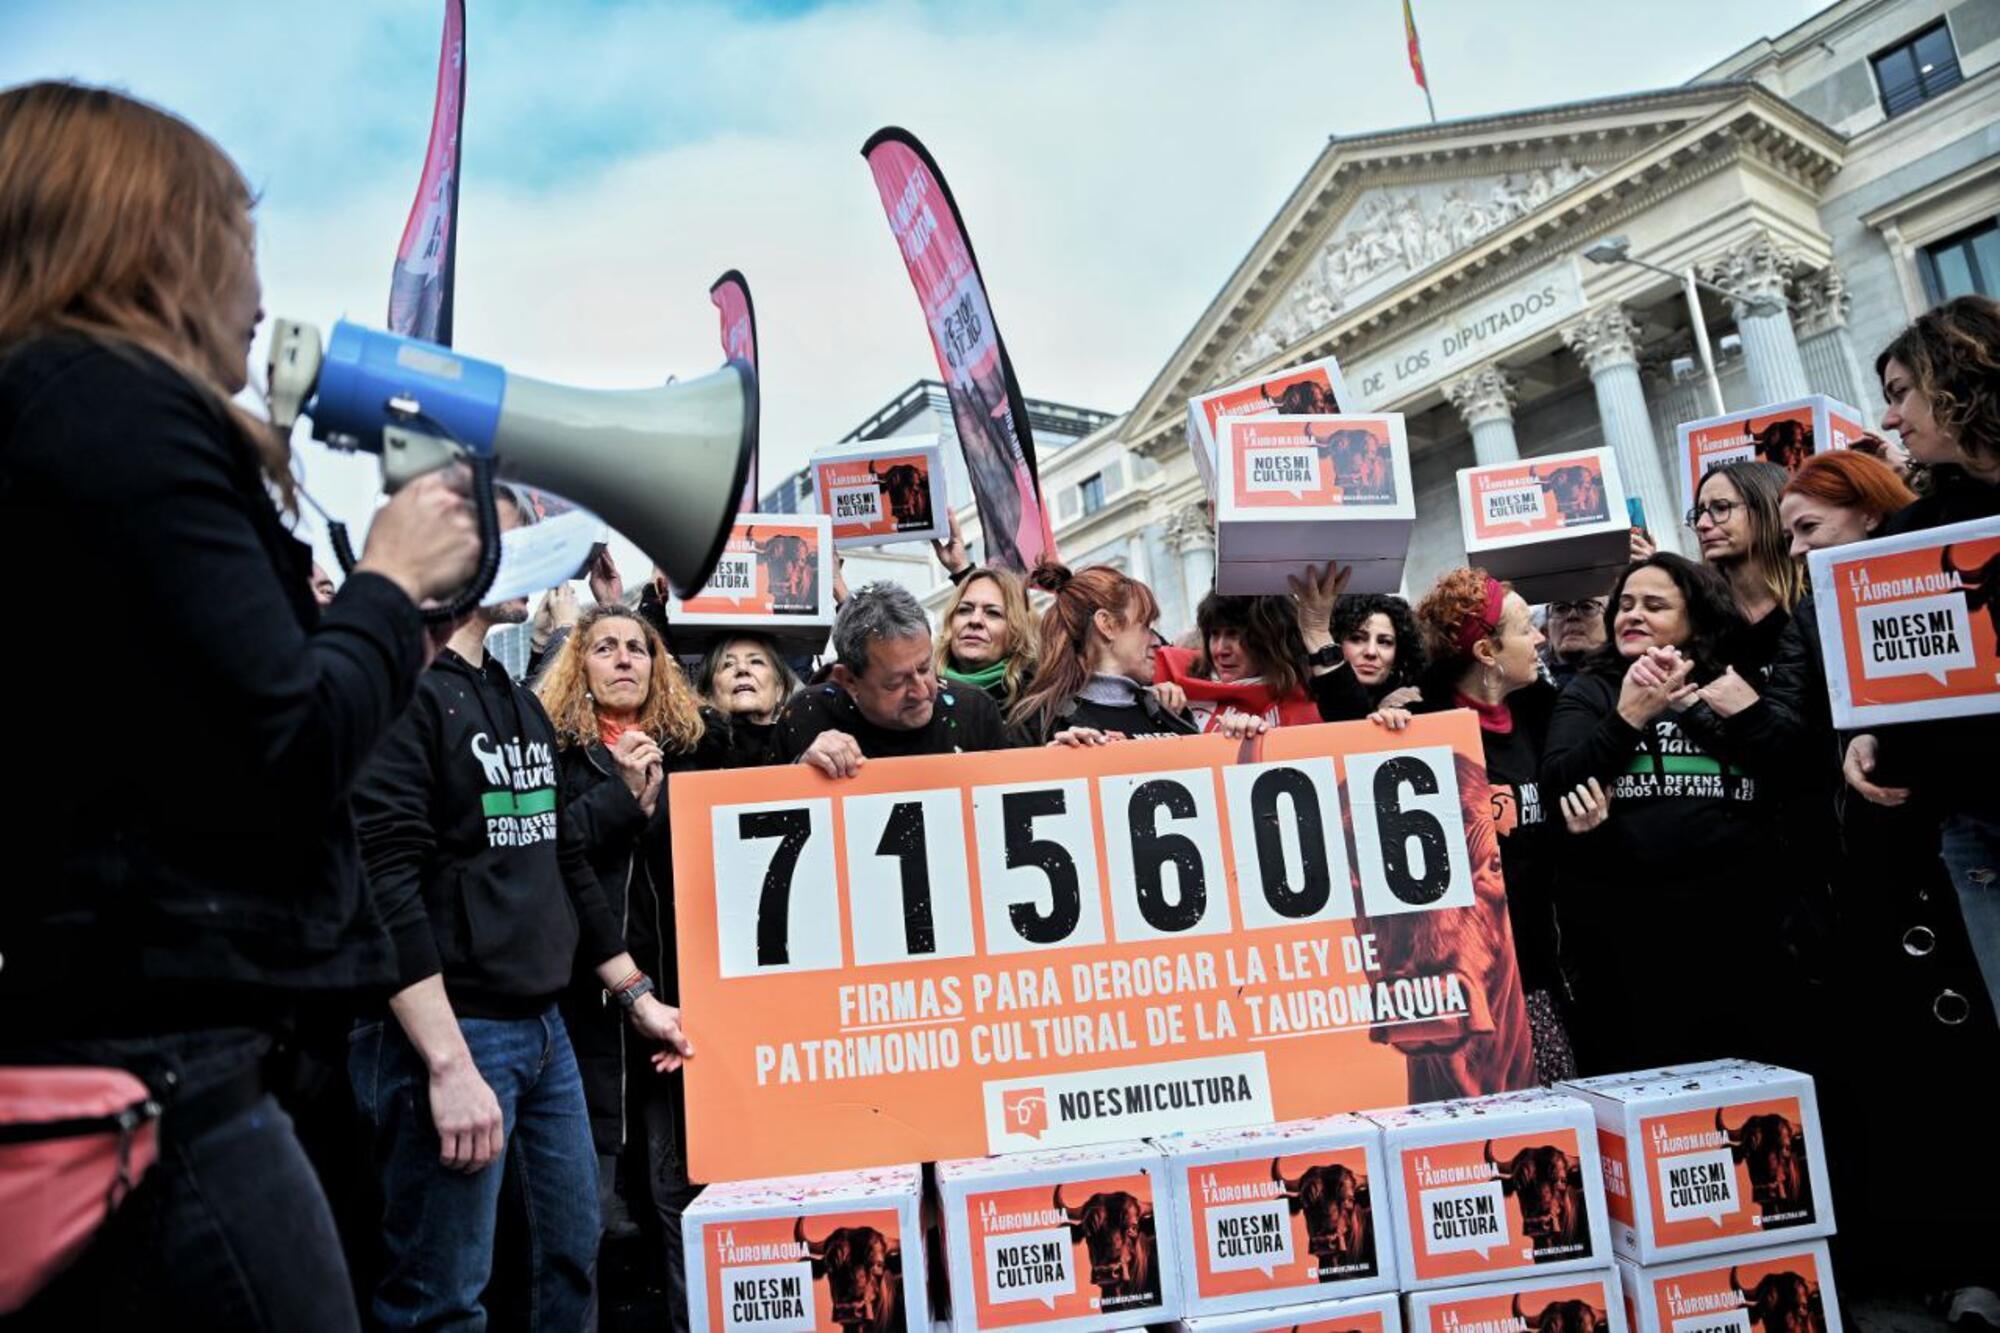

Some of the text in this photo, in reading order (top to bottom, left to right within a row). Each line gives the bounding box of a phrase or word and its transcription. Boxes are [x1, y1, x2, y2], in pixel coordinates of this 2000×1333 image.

[1363, 286, 1556, 396] DE LOS DIPUTADOS
[1254, 470, 1312, 482] CULTURA
[837, 504, 877, 518] CULTURA
[1490, 504, 1538, 518] CULTURA
[707, 575, 750, 588] ULTURA
[1849, 568, 1869, 587] LA
[1852, 570, 1963, 602] TAUROMAQUIA
[1873, 633, 1960, 662] CULTURA
[1639, 774, 1658, 786] LA
[1665, 775, 1722, 787] DEFENS
[1656, 785, 1682, 797] LOS
[839, 933, 1381, 1026] FIRMAS PARA DEROGAR LA LEY DE
[756, 974, 1467, 1086] PATRIMONIO CULTURAL DE LA TAUROMAQUIA
[1651, 1124, 1668, 1141] LA
[1654, 1130, 1730, 1154] TAUROMAQUIA
[1414, 1156, 1431, 1172] LA
[1416, 1162, 1499, 1187] TAUROMAQUIA
[1200, 1173, 1216, 1188] LA
[1202, 1180, 1287, 1203] TAUROMAQUIA
[1670, 1183, 1731, 1208] CULTURA
[979, 1200, 997, 1217] LA
[981, 1208, 1069, 1233] TAUROMAQUIA
[1433, 1216, 1499, 1240] CULTURA
[717, 1230, 734, 1247] LA
[1217, 1233, 1284, 1258] CULTURA
[718, 1241, 811, 1264] TAUROMAQUIA
[997, 1263, 1065, 1289] CULTURA
[1666, 1284, 1682, 1301] LA
[1669, 1290, 1746, 1316] TAUROMAQUIA
[733, 1299, 804, 1323] CULTURA
[1442, 1310, 1458, 1326] LA
